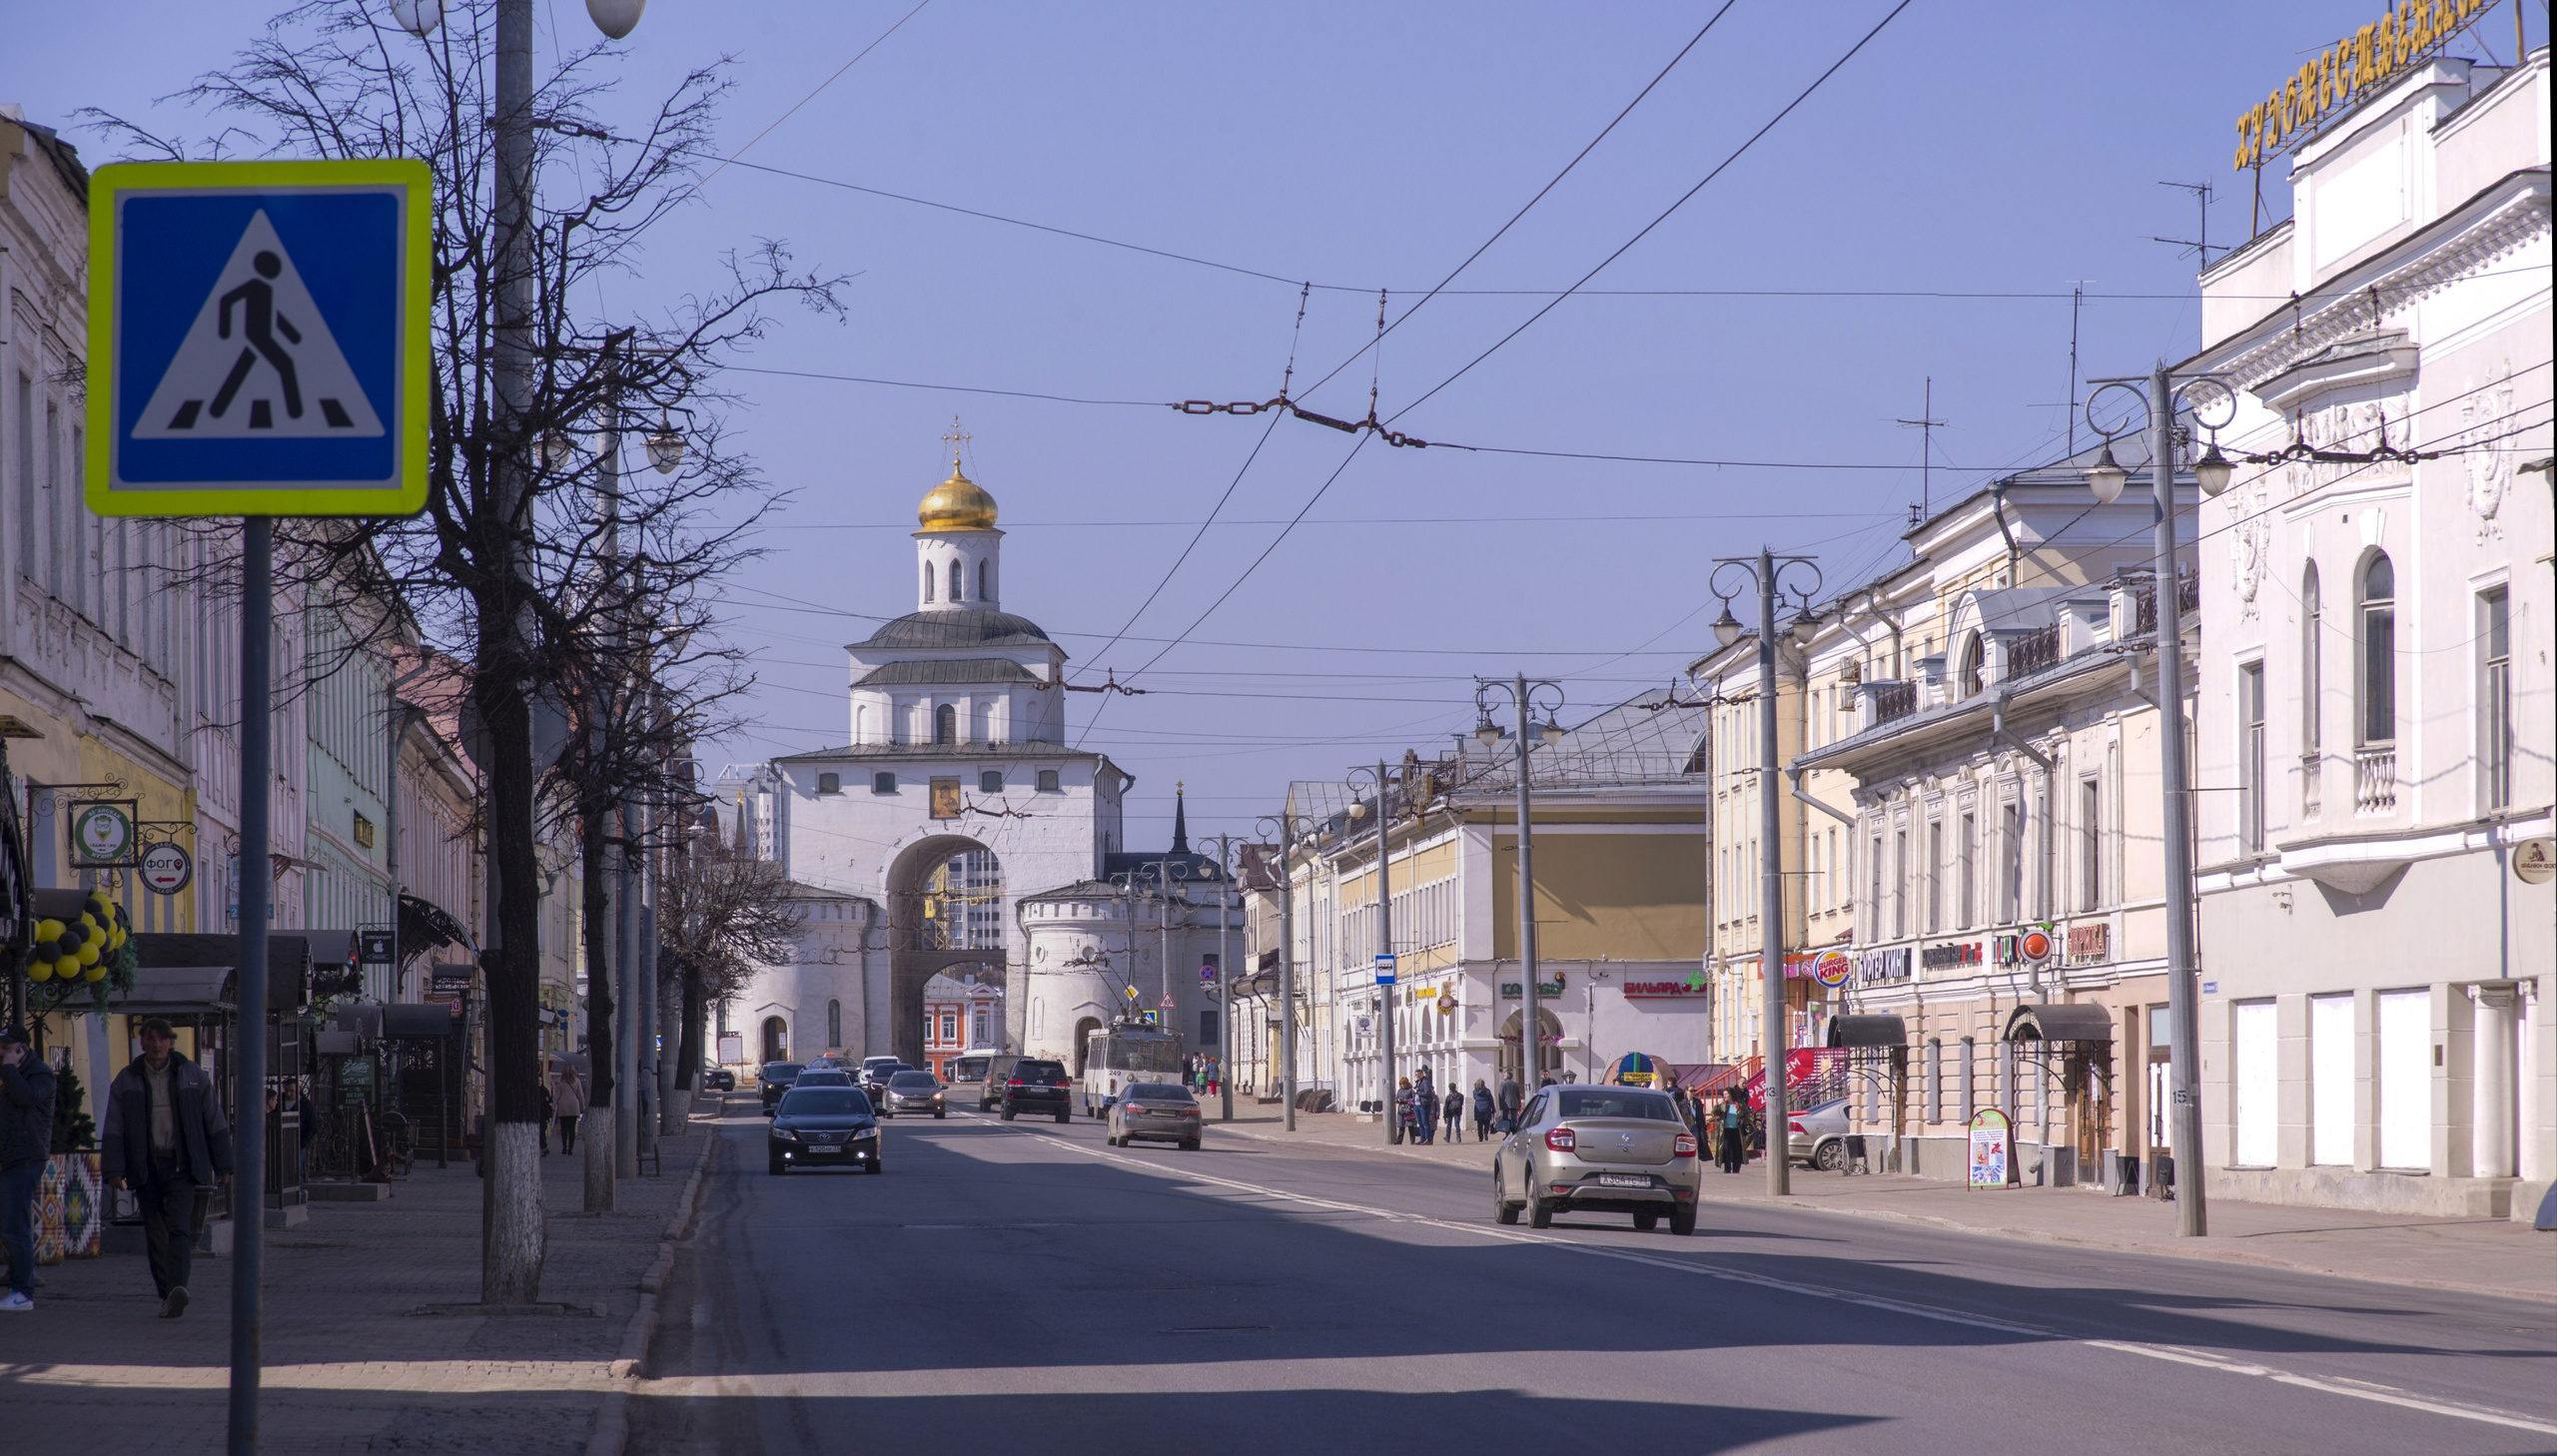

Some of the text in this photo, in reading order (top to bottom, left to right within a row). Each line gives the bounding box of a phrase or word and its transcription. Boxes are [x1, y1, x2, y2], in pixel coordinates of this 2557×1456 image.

[1818, 956, 1848, 971] BURGER
[1859, 948, 1906, 982] БУРГЕР КИНГ
[1819, 964, 1849, 981] KING
[1624, 982, 1682, 995] БИЛЬЯРД
[1766, 1087, 1776, 1097] 13
[2172, 1090, 2187, 1104] 15
